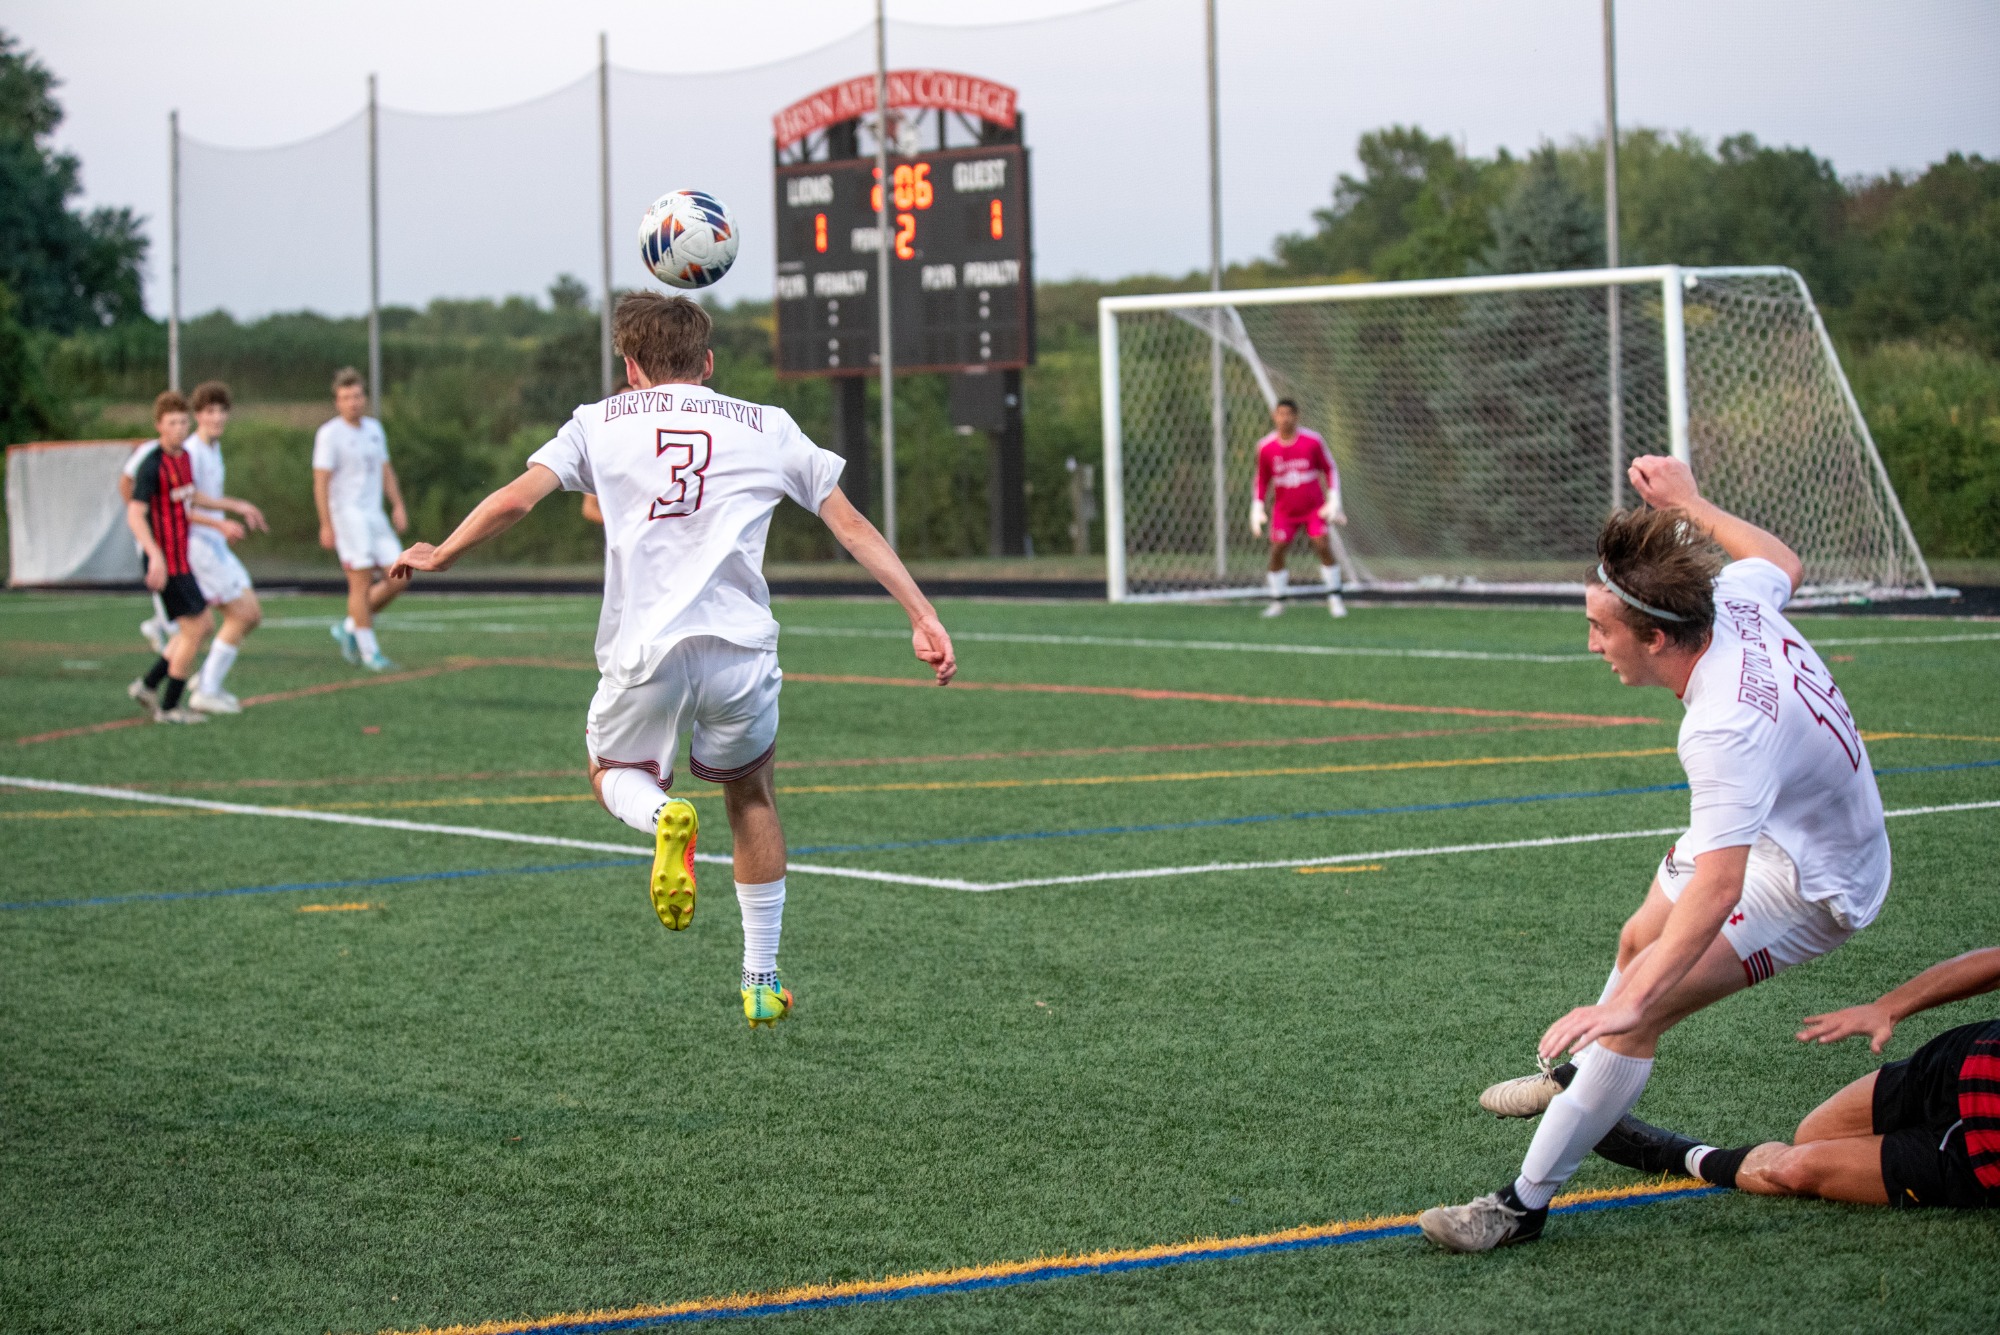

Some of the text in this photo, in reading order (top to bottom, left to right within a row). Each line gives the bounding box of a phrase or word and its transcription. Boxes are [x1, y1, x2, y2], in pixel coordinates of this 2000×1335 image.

[913, 70, 1010, 118] COLLEGE
[787, 174, 834, 207] LIONS
[953, 158, 1007, 192] GUEST
[815, 213, 828, 253] 1
[895, 213, 917, 260] 2
[990, 199, 1003, 240] 1
[814, 270, 868, 297] PENALTY
[963, 260, 1020, 287] PENALTY
[605, 392, 763, 433] BRYN ATHYN
[649, 428, 712, 521] 3
[1738, 648, 1779, 723] BRYN
